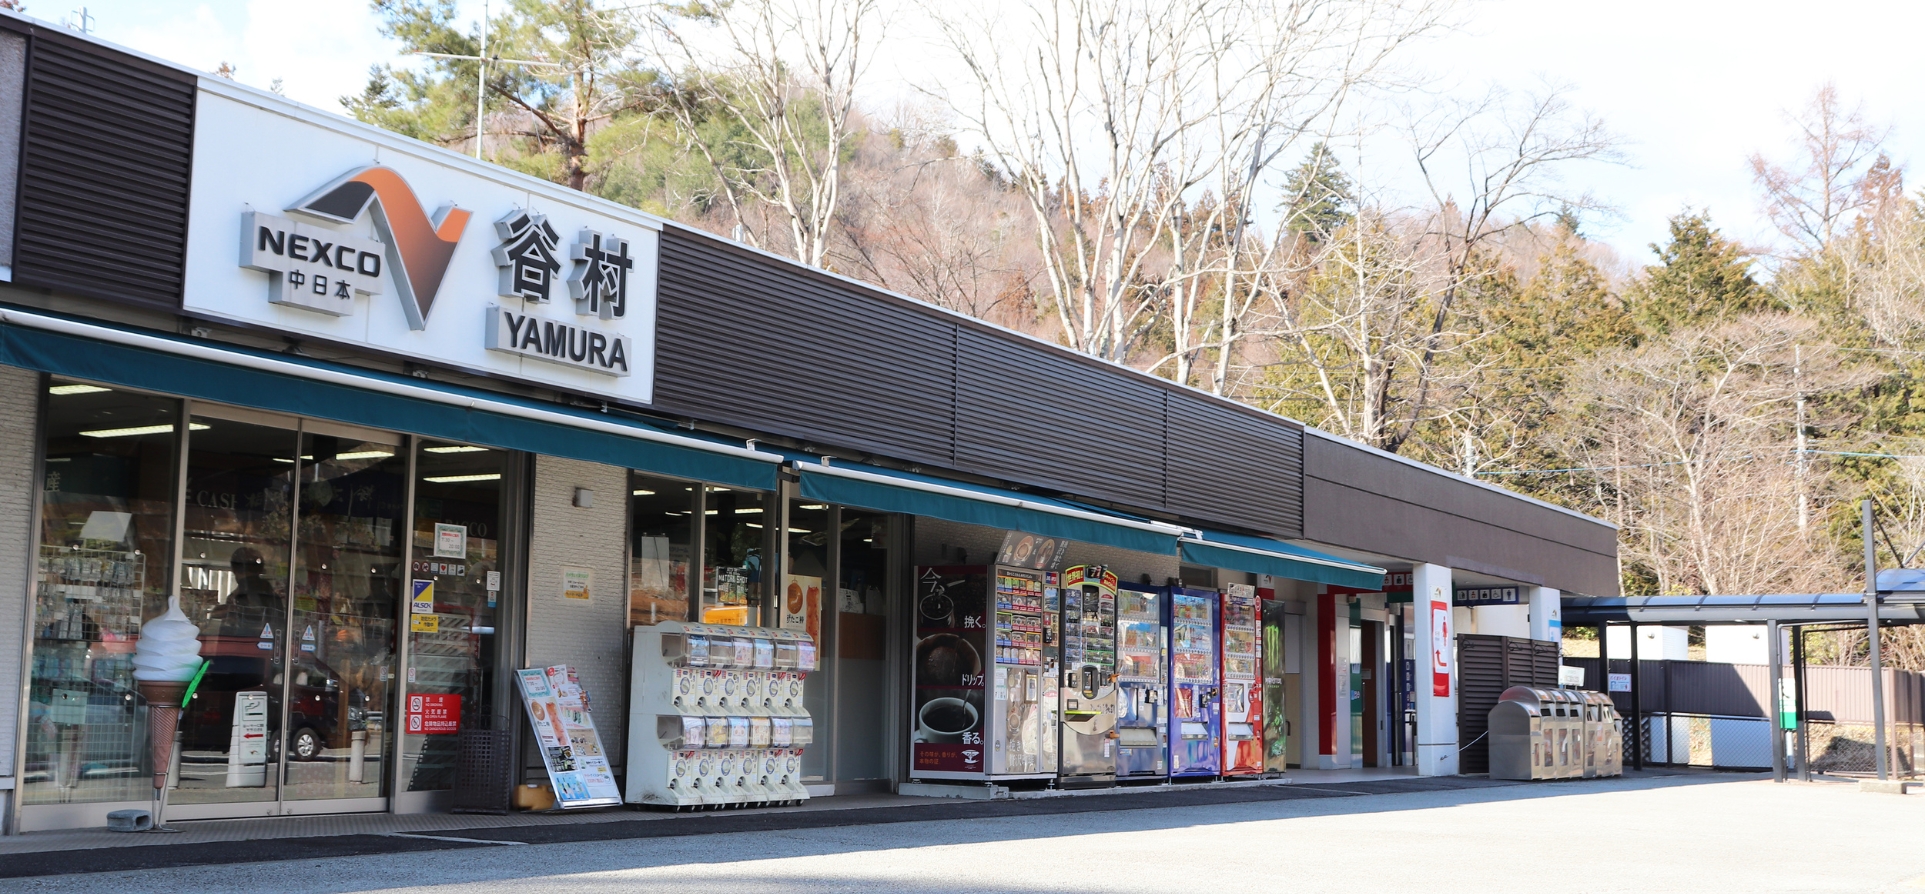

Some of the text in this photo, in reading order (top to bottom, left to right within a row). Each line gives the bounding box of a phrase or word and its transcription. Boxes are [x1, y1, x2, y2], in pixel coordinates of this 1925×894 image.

[258, 226, 382, 278] NEXCO
[507, 212, 633, 318] 谷村
[288, 269, 351, 300] 中日本
[504, 311, 629, 372] YAMURA
[964, 615, 986, 629] 挽く。
[962, 673, 985, 687] ドリップ。
[961, 731, 984, 745] 香る。
